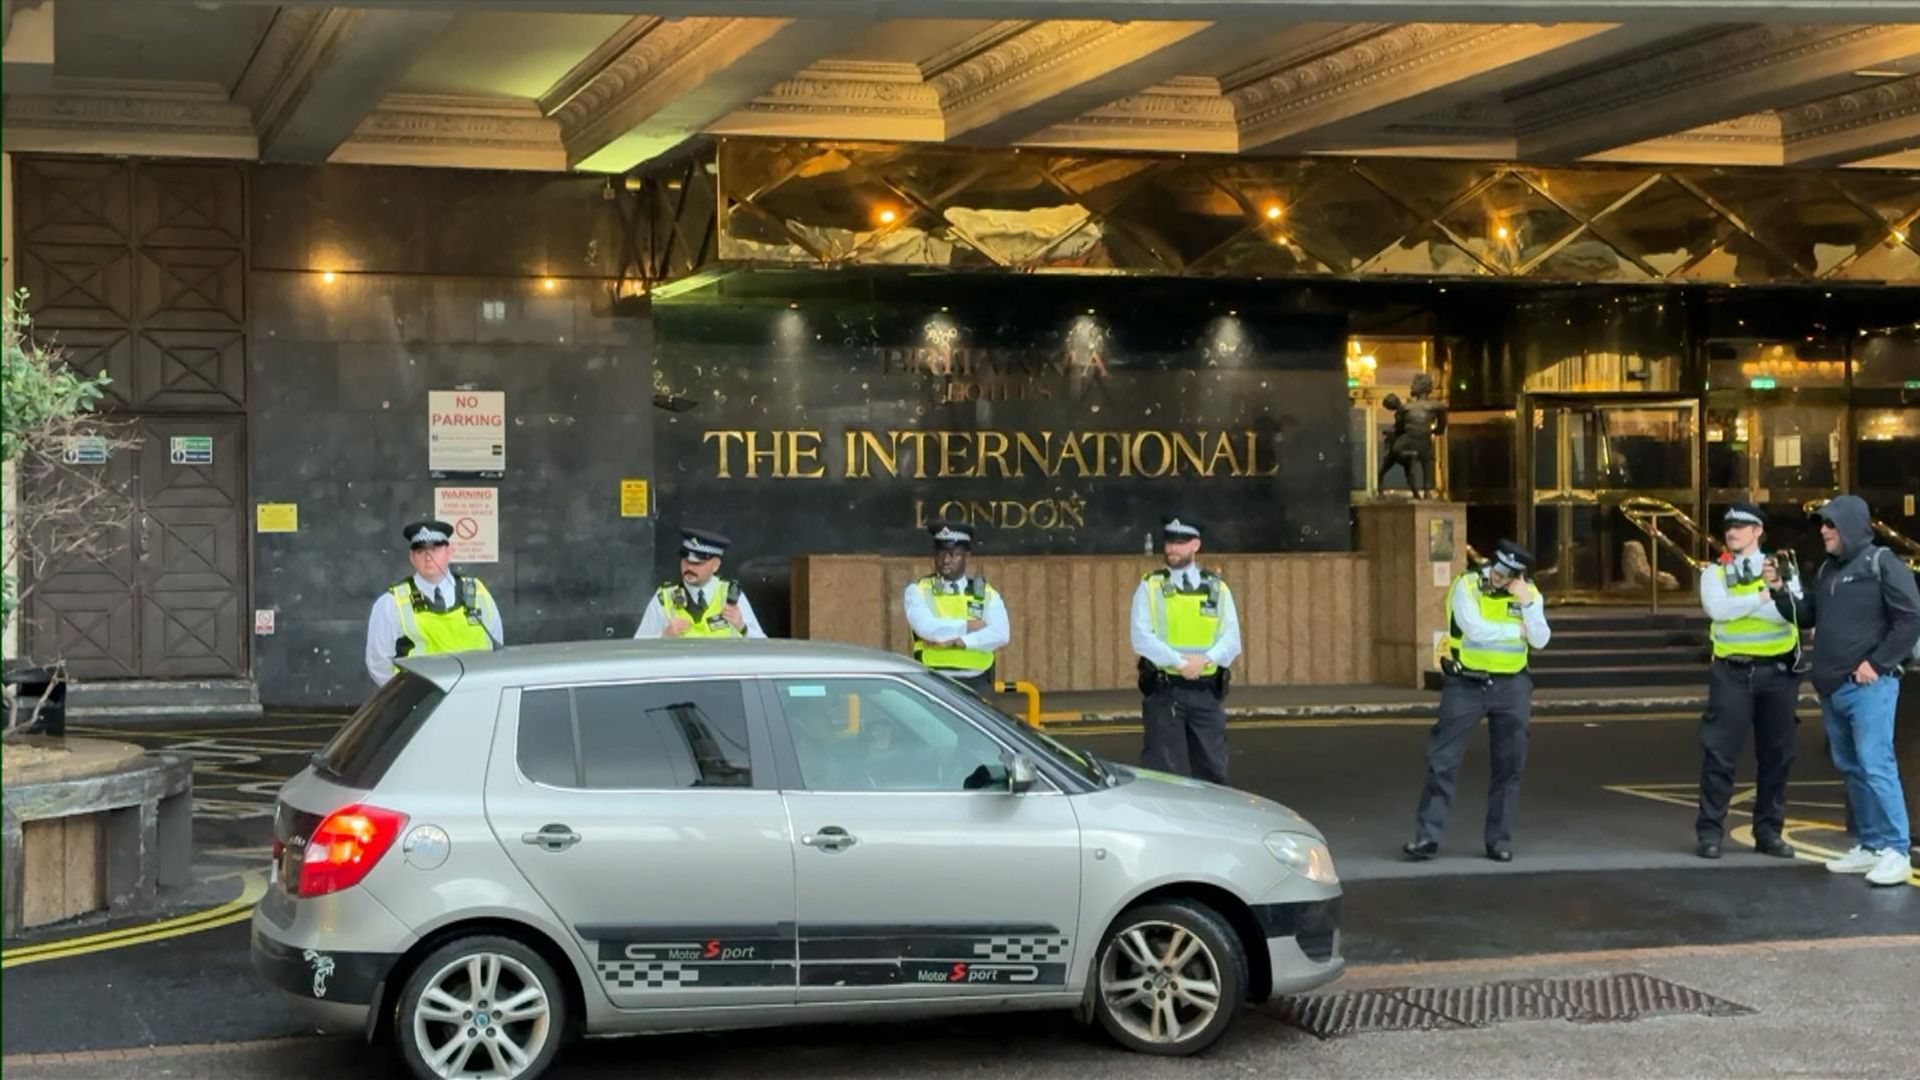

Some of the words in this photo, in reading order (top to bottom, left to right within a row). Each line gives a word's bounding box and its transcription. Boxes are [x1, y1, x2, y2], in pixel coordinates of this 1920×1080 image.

[882, 346, 1111, 377] BRITANNIA
[456, 395, 478, 407] NO
[432, 413, 502, 427] PARKING
[702, 429, 826, 479] THE
[844, 429, 1281, 479] INTERNATIONAL
[441, 490, 492, 500] WARNING
[914, 499, 1087, 530] LONDON
[668, 946, 700, 960] Motor
[702, 938, 756, 961] Sport
[917, 968, 949, 982] Motor
[948, 962, 999, 984] Sport
